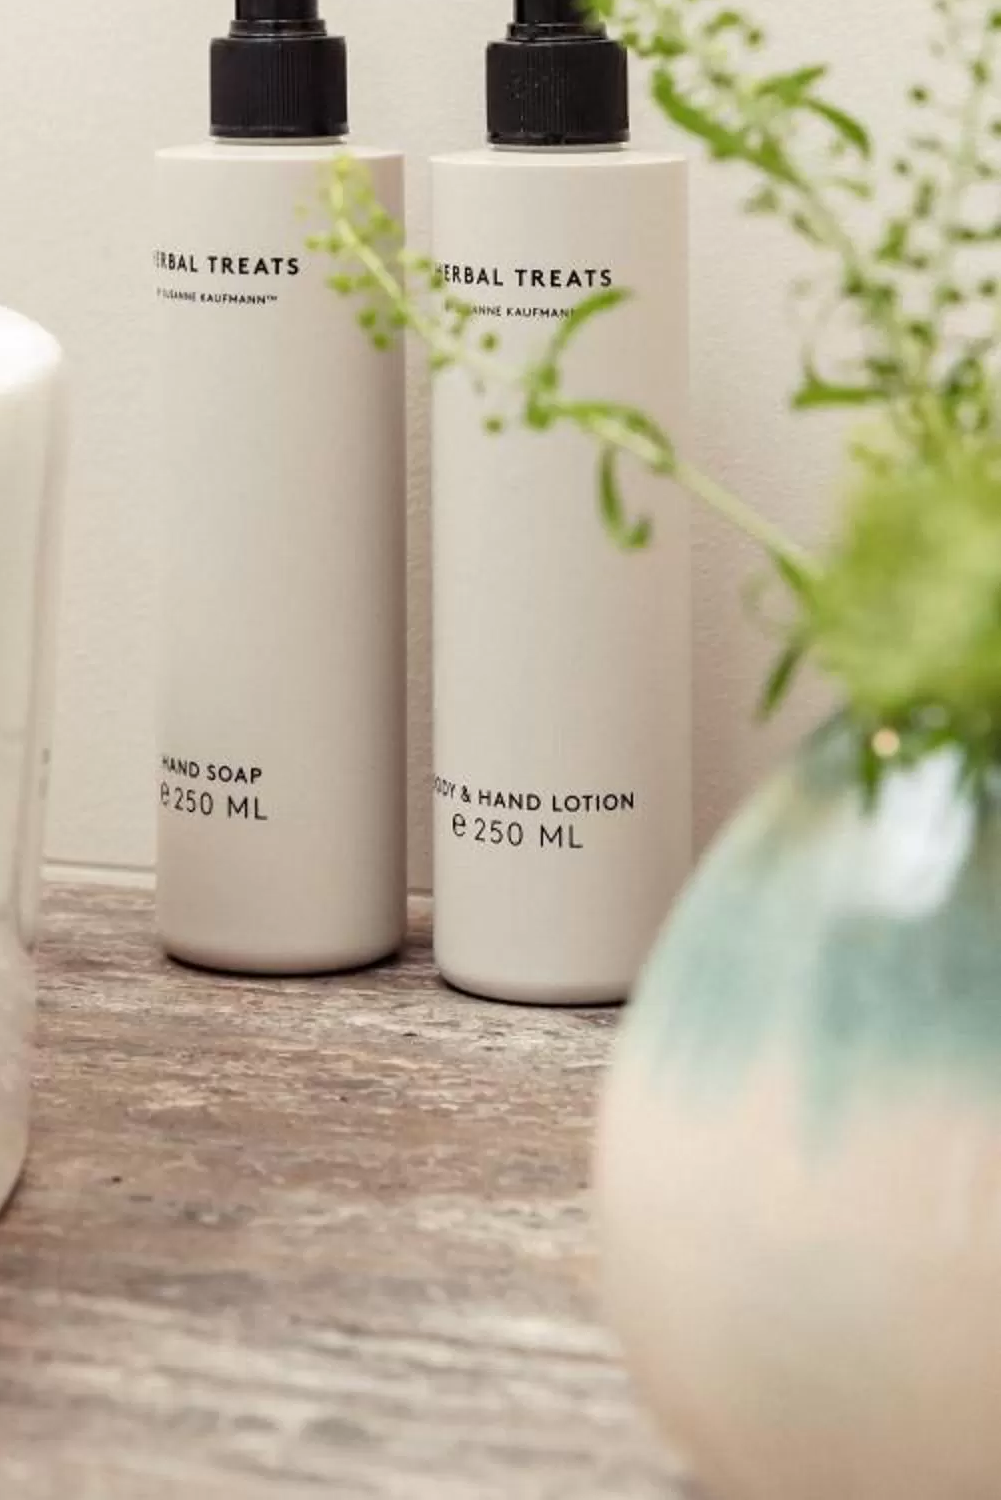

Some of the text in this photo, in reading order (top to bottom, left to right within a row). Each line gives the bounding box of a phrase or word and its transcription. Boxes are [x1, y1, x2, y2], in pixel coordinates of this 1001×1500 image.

[207, 256, 300, 275] TREATS
[515, 269, 613, 288] TREATS
[206, 764, 262, 784] SOAP
[174, 786, 214, 816] 250
[227, 795, 268, 821] ML
[433, 775, 635, 813] ODY & HAND LOTION
[474, 817, 524, 847] 250
[540, 824, 584, 849] ML
